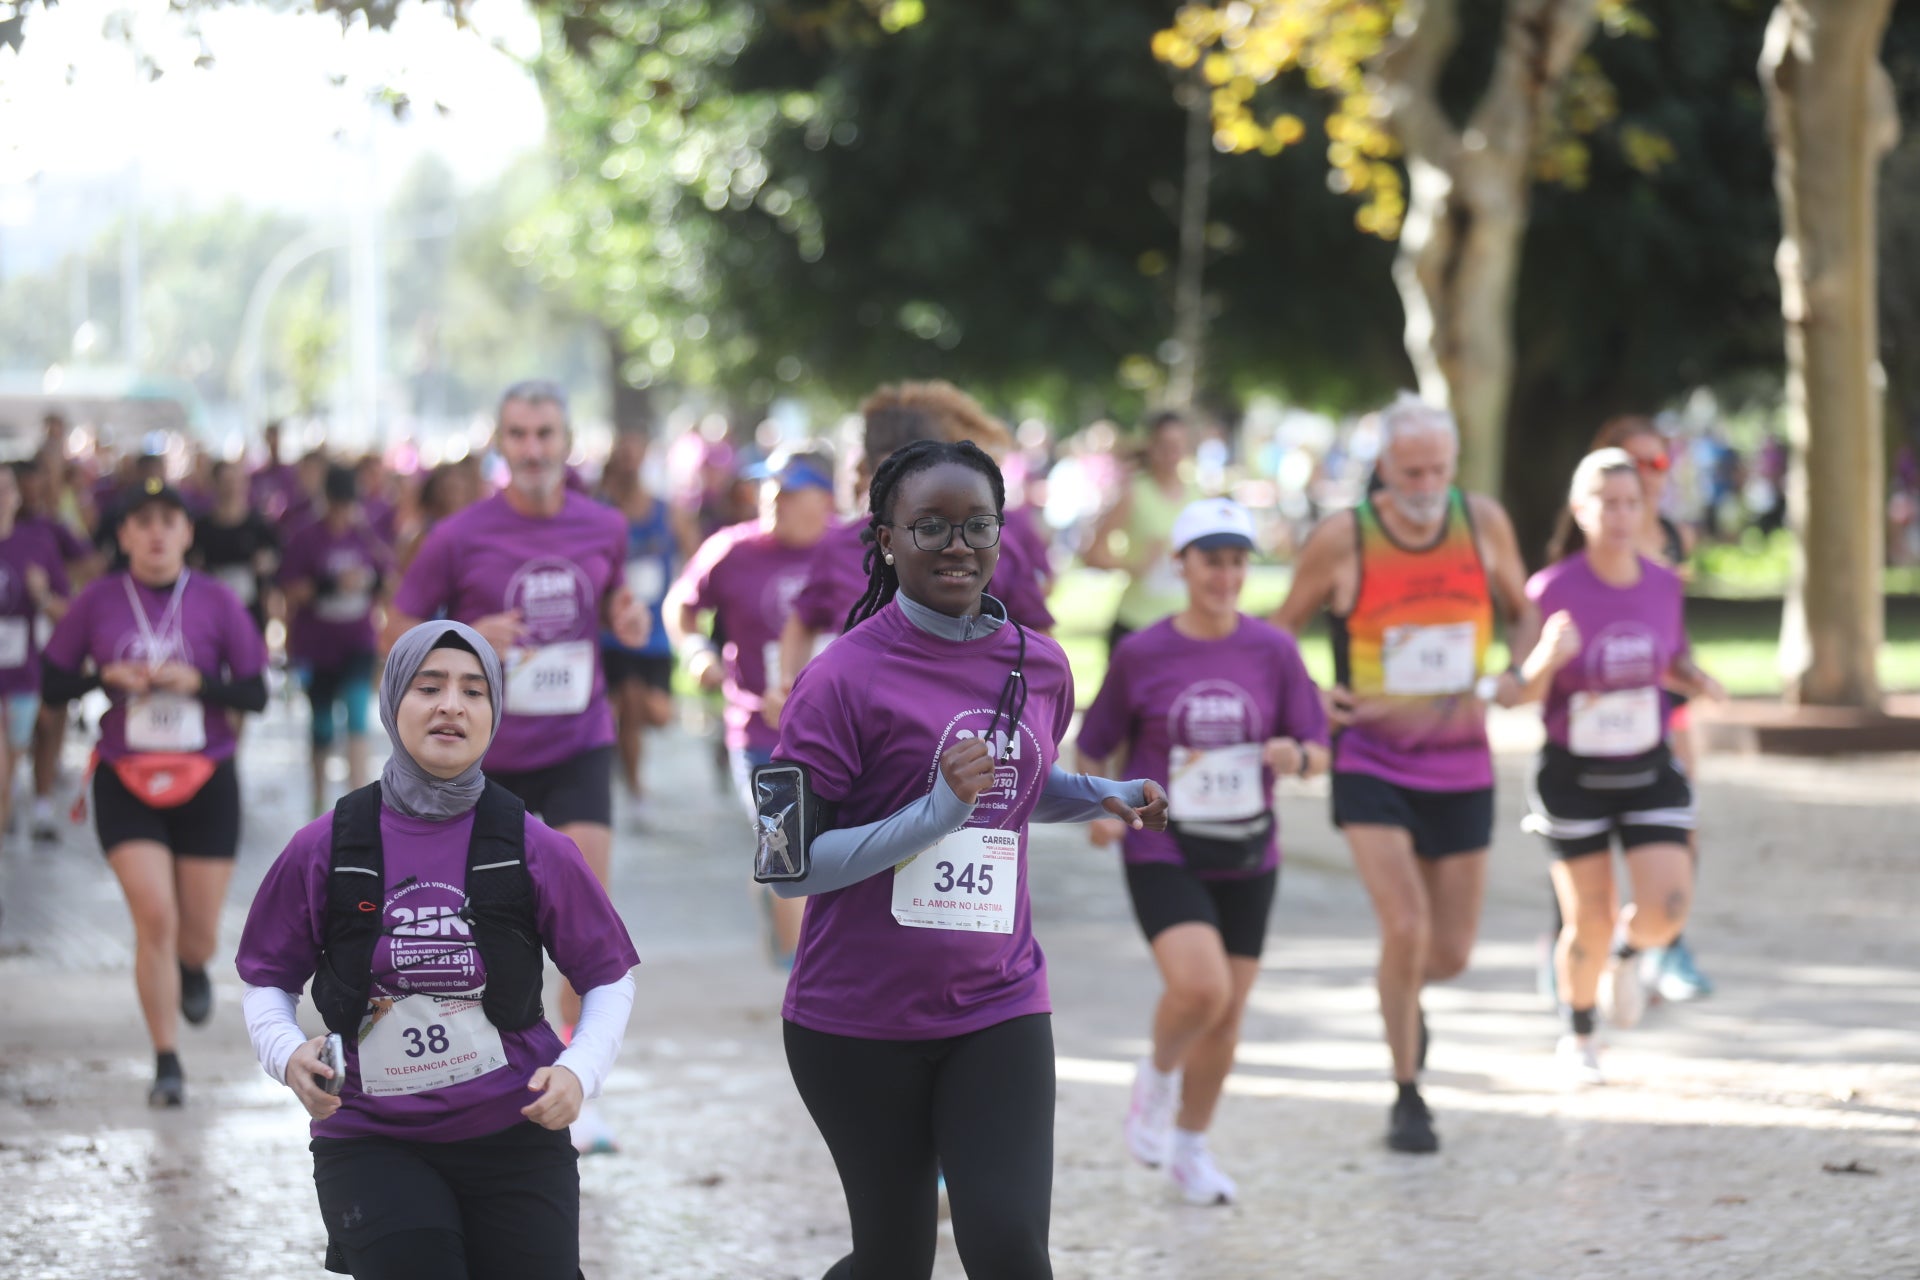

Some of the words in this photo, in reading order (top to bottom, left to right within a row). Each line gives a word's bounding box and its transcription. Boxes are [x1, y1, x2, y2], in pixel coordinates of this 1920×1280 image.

[930, 720, 956, 770] INTERNACIONAL
[953, 709, 974, 723] CONTRA
[999, 779, 1012, 788] 30
[982, 835, 1016, 846] CARRERA
[934, 861, 994, 895] 345
[393, 883, 420, 900] CONTRA
[431, 881, 466, 900] VIOLENCIA
[912, 898, 925, 906] EL
[927, 900, 957, 909] AMOR
[958, 901, 972, 910] NO
[973, 903, 1003, 912] LASTIMA
[390, 907, 470, 936] 25N
[452, 955, 469, 965] 30
[402, 1024, 450, 1058] 38
[384, 1059, 448, 1076] TOLERANCIA
[449, 1051, 478, 1066] CERO
